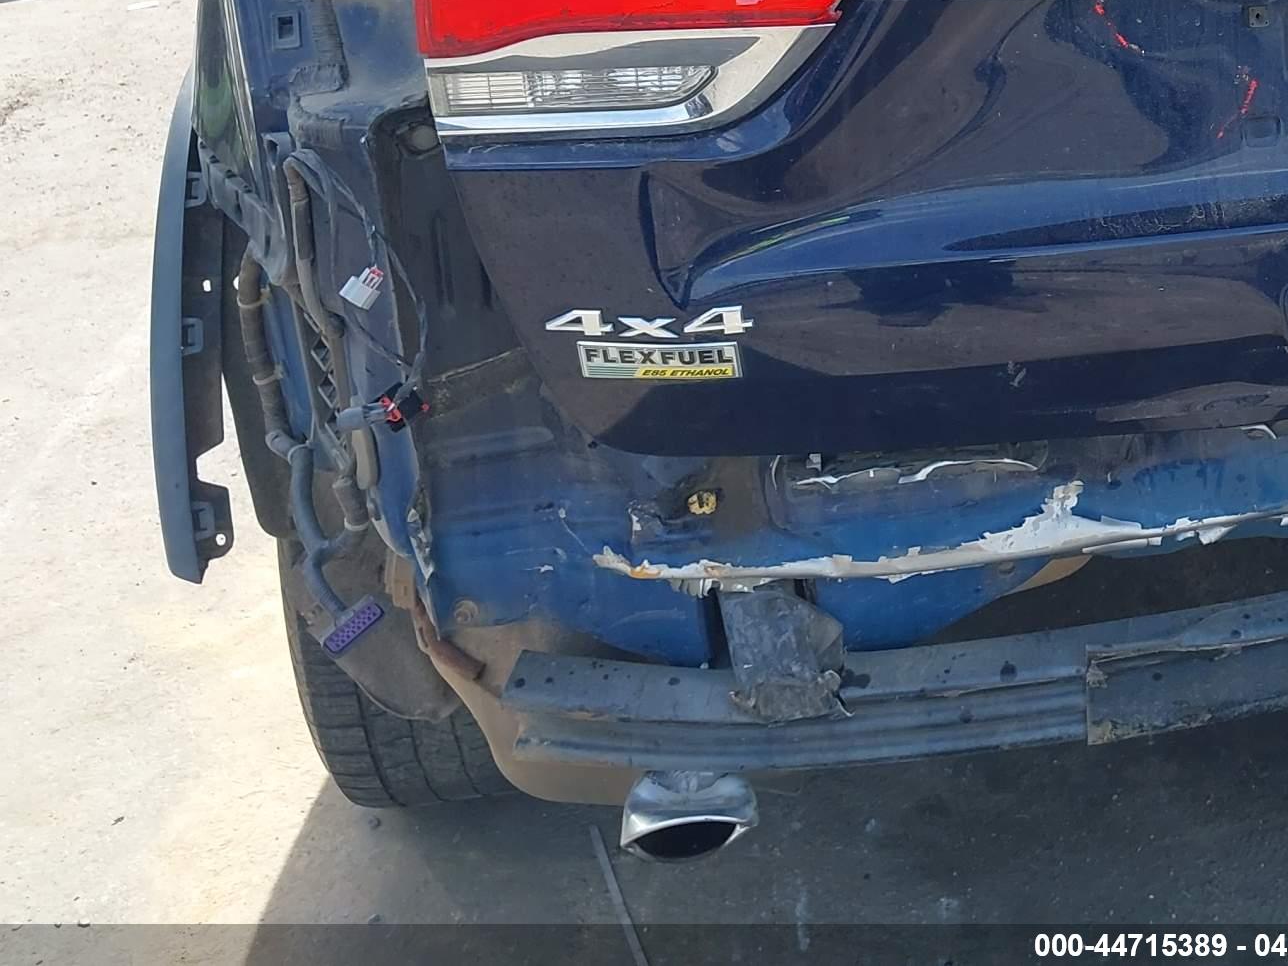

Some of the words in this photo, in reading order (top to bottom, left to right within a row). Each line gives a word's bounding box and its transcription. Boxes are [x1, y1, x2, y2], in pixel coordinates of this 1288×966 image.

[545, 305, 754, 339] 4x4
[584, 348, 734, 366] FLEXFUEL
[641, 368, 668, 378] E85
[670, 367, 731, 378] ETHANOL
